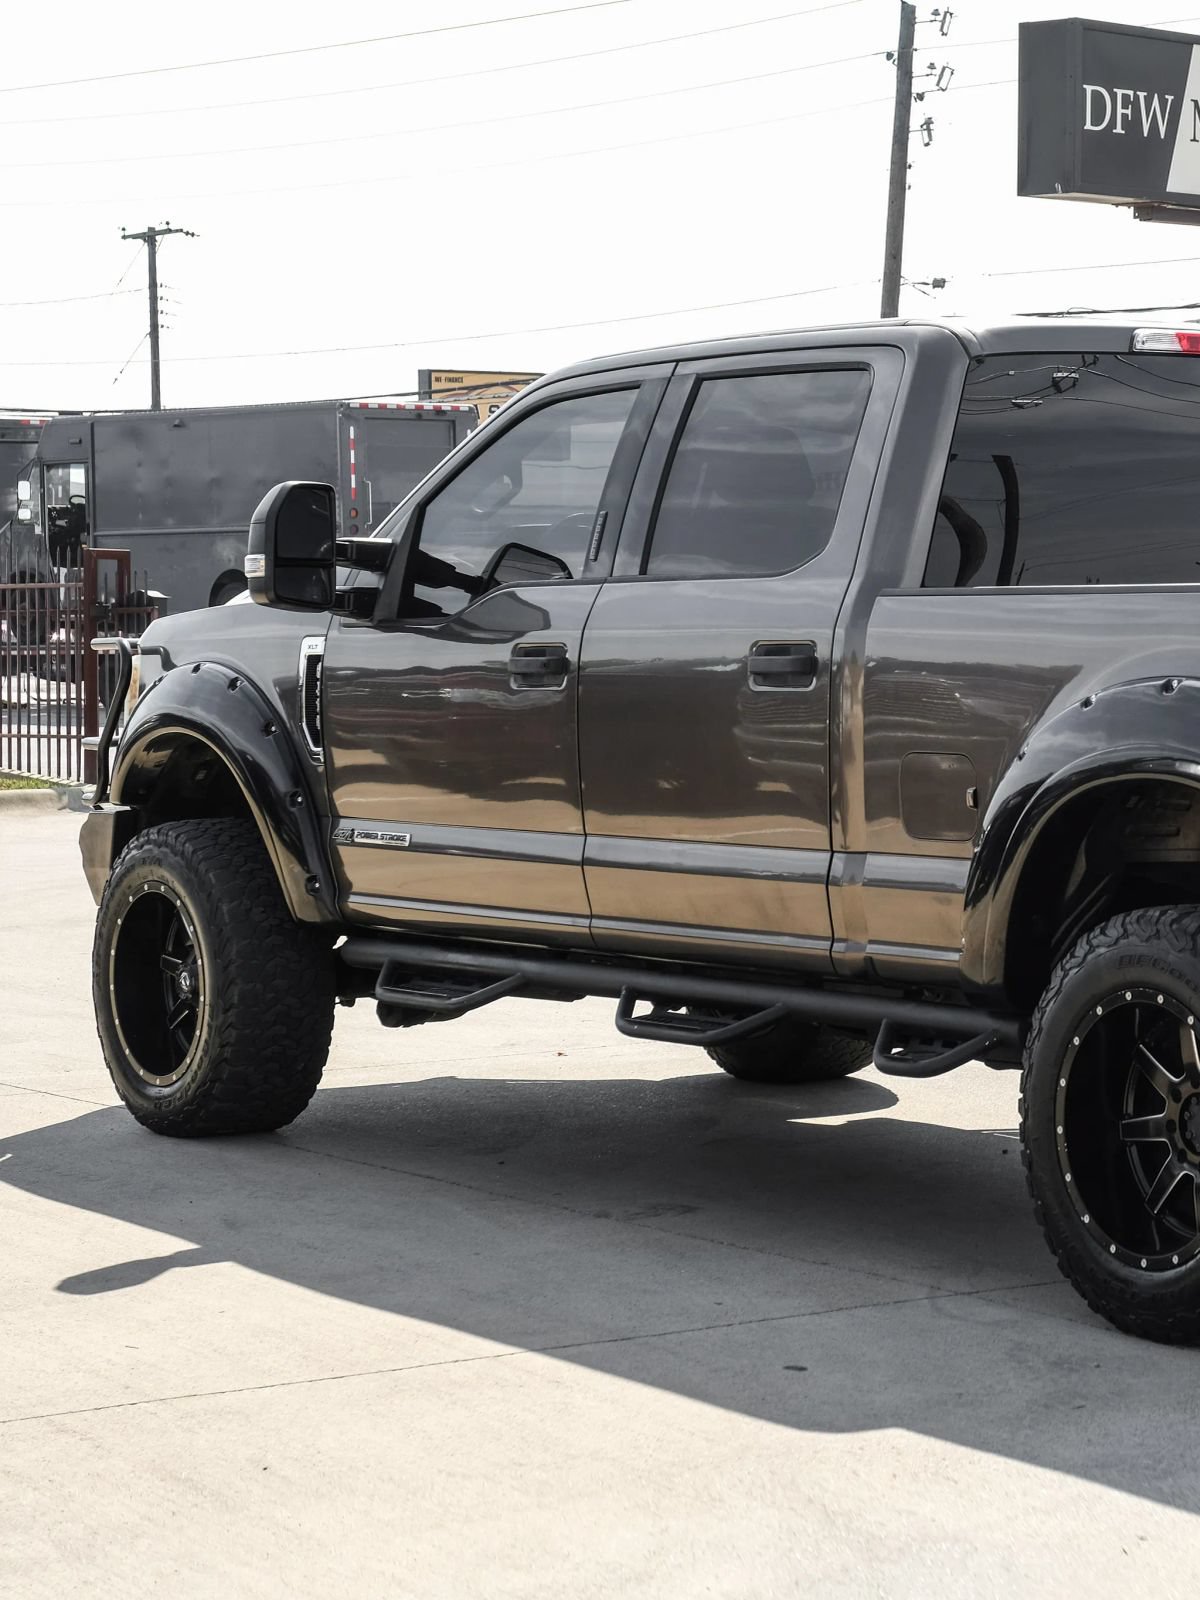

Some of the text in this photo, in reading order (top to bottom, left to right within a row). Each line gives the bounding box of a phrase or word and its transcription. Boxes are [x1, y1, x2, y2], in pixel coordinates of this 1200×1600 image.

[1082, 84, 1175, 140] DFW
[444, 376, 464, 384] FINANCE
[355, 831, 379, 840] POWER
[380, 833, 408, 842] STROKE
